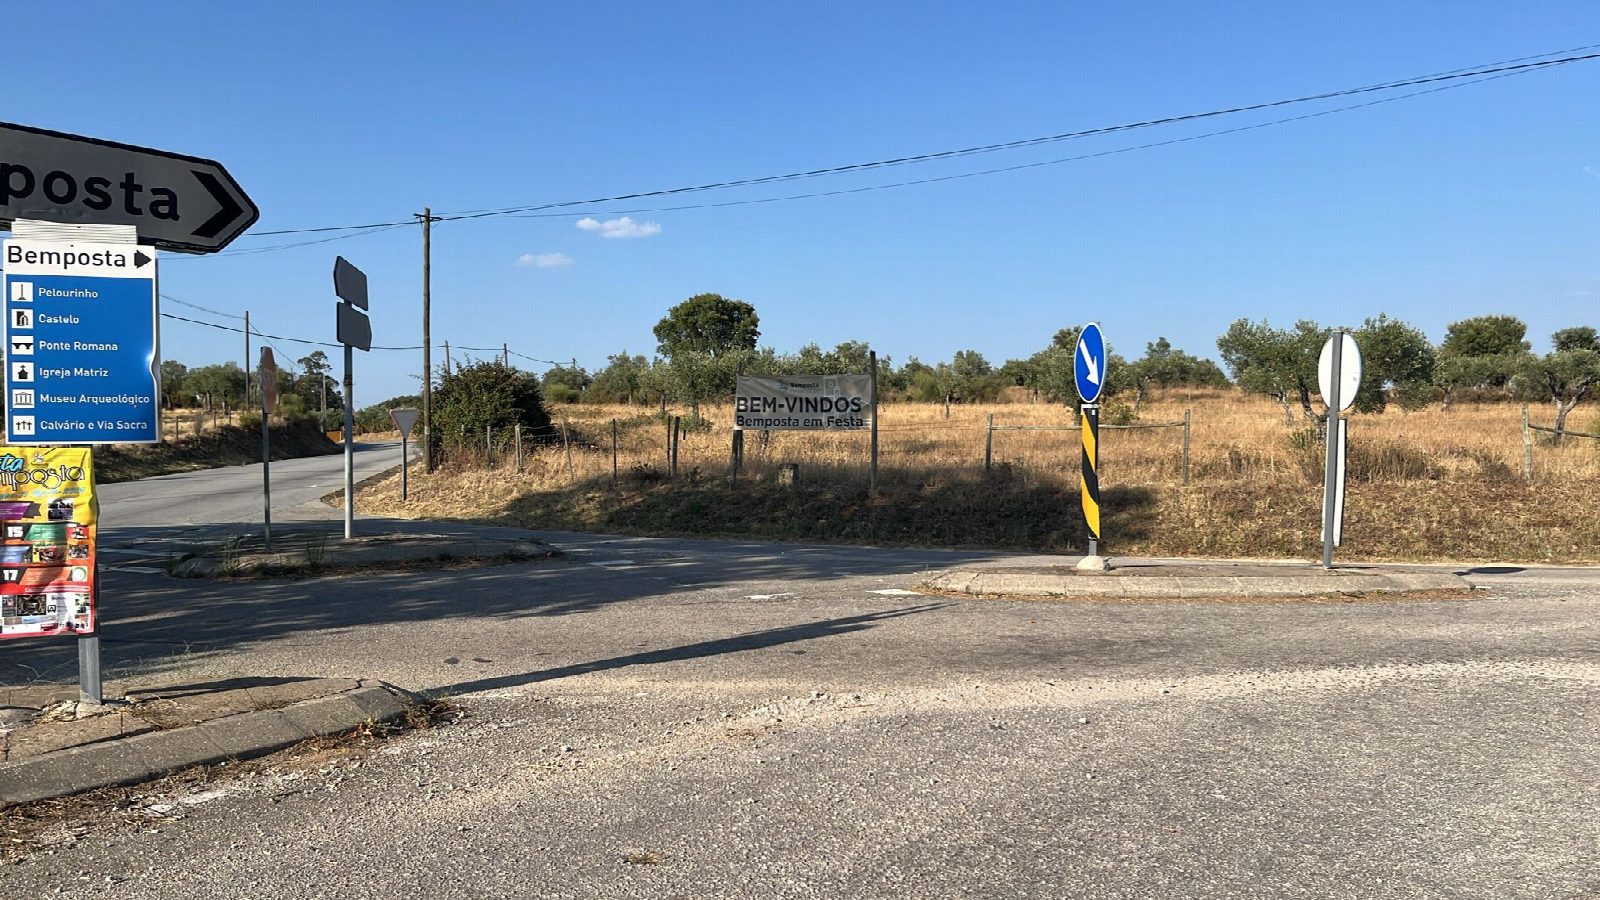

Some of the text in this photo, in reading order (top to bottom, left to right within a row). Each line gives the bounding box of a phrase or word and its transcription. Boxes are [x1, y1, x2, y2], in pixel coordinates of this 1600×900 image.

[8, 245, 126, 269] Bemposta
[38, 287, 98, 298] Pelourinho
[38, 313, 80, 324] Castelo
[39, 341, 118, 351] Ponte Romana
[39, 367, 109, 378] Igreja Matriz
[40, 393, 150, 405] Museu Arqueológico
[736, 396, 862, 413] BEM-VINDOS
[40, 420, 148, 430] Calvário e Via Sacra
[736, 415, 864, 428] Bemposta em Festa
[7, 526, 24, 538] 15
[3, 569, 19, 581] 17
